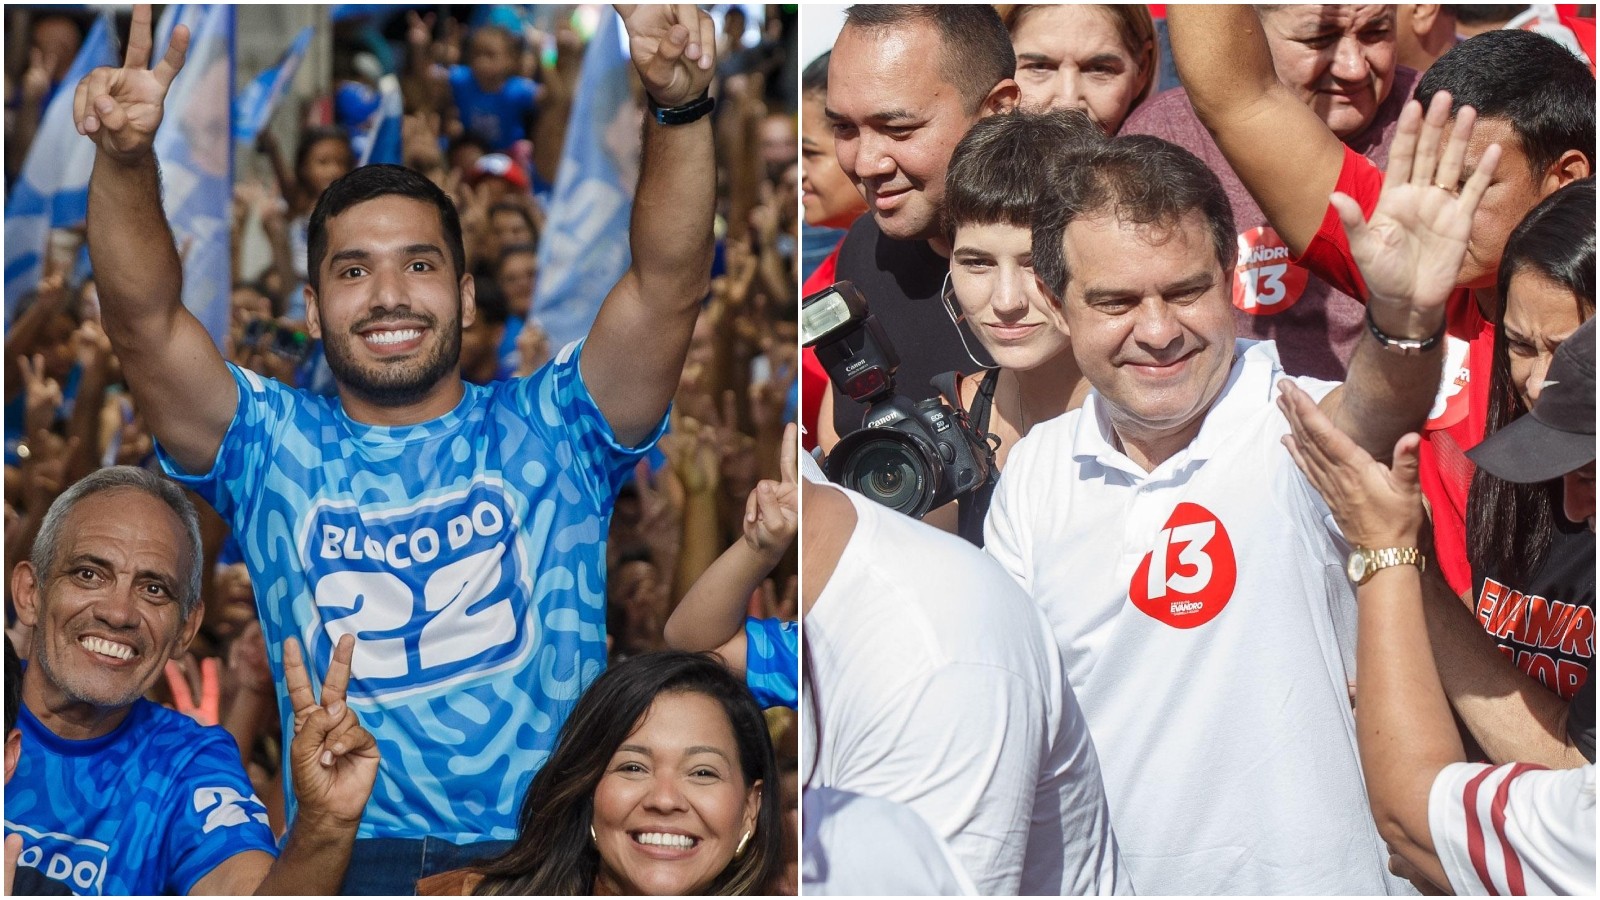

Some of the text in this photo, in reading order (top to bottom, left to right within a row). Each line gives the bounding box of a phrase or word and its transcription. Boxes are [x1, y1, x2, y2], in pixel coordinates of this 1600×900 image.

[1240, 263, 1288, 309] 13
[845, 359, 866, 372] Canon
[868, 411, 898, 428] Canon
[930, 412, 944, 422] EOS
[320, 501, 504, 569] BLOCO DO
[1144, 520, 1216, 600] 13
[315, 541, 517, 681] 22
[1170, 602, 1203, 613] EVANDRO
[1476, 577, 1596, 658] EVANDR
[46, 852, 99, 889] DO
